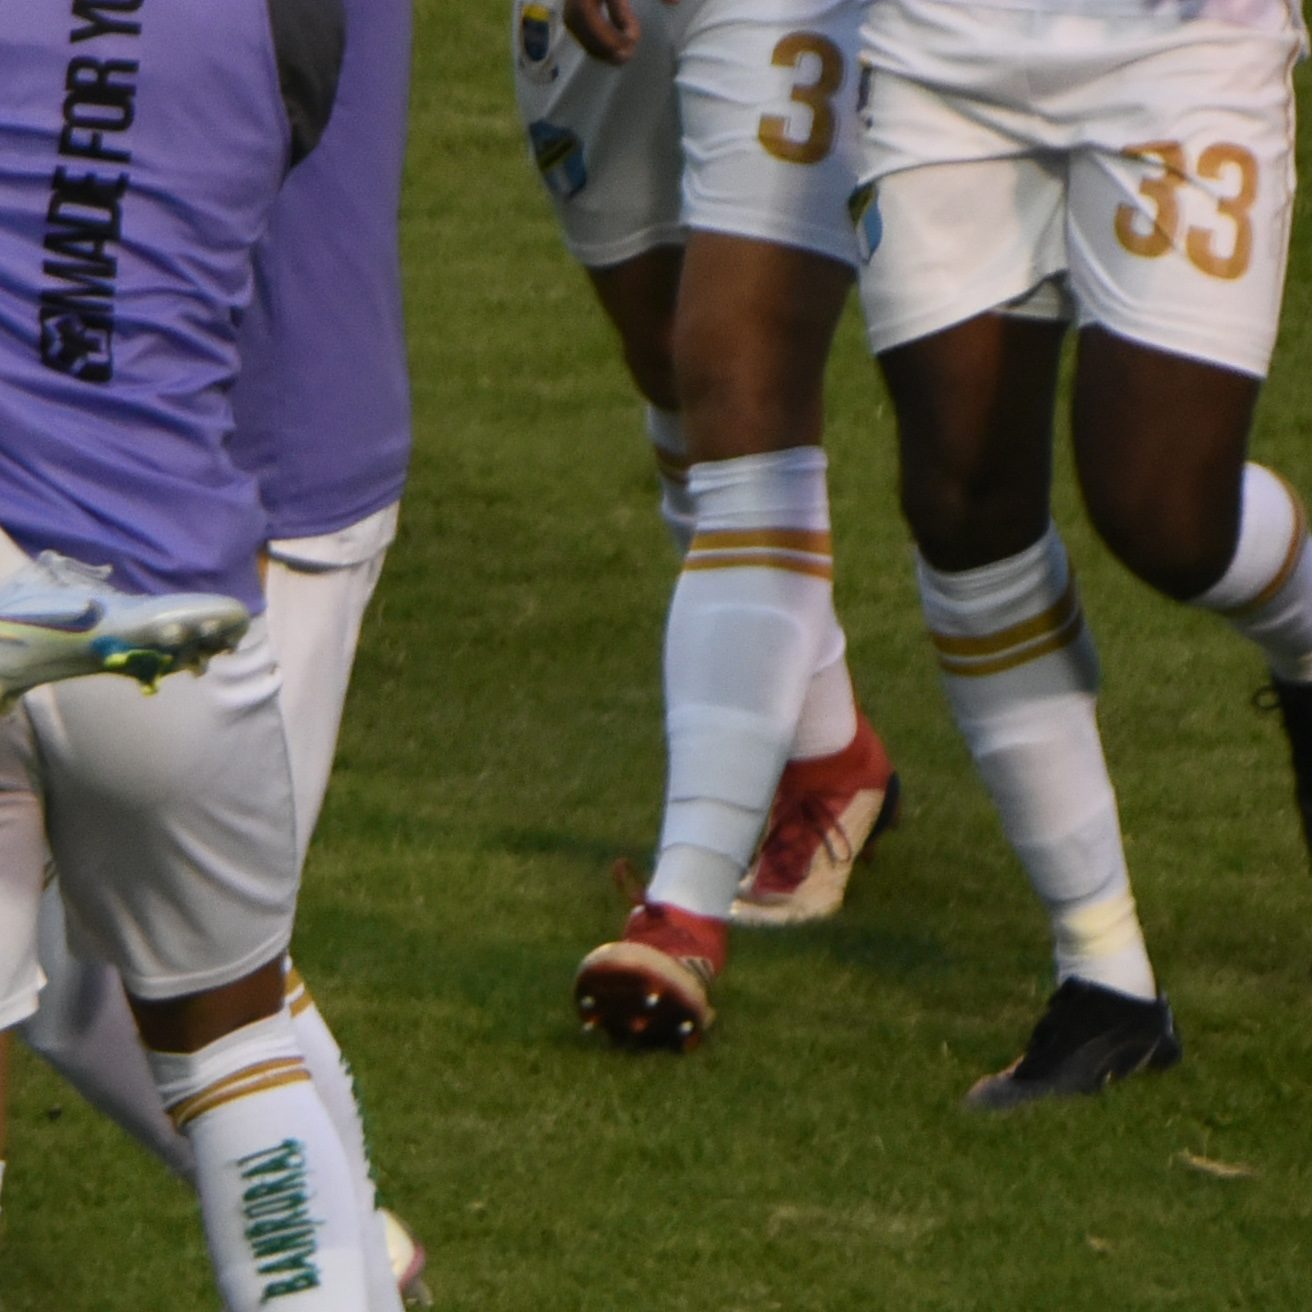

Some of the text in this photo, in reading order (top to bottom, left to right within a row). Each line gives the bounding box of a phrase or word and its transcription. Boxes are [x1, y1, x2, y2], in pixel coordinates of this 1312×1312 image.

[58, 56, 140, 164] FOR
[758, 32, 844, 165] 3
[40, 165, 131, 329] MADE
[1114, 141, 1258, 280] 33
